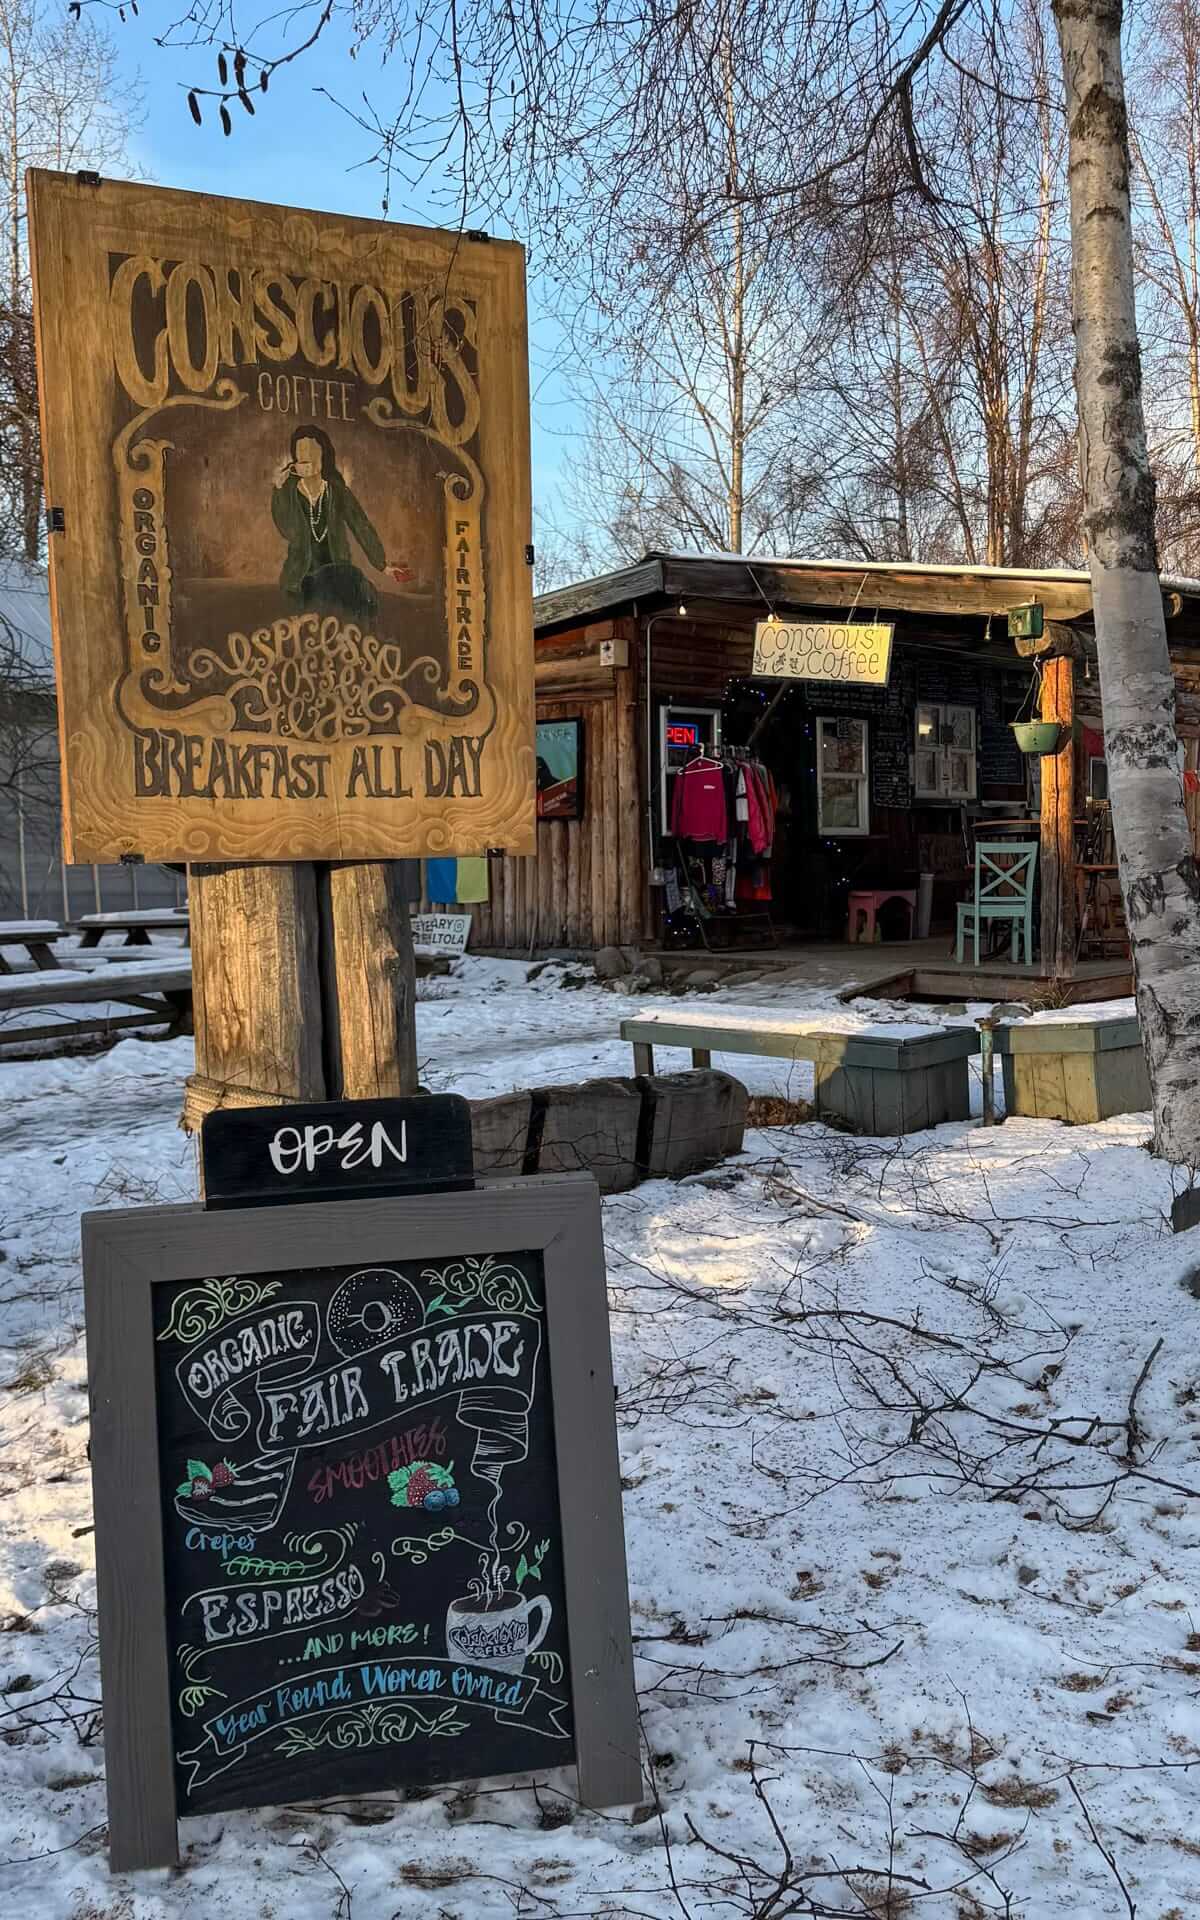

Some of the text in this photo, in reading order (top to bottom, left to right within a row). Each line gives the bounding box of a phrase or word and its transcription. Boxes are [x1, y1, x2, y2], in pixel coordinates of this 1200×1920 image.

[110, 254, 481, 446] CONSCIOUS
[256, 370, 356, 422] COFFEE
[132, 487, 161, 653] ORGANIC
[133, 727, 489, 800] BREAKFAST ALL DAY
[268, 1119, 407, 1175] OPEN
[187, 1309, 312, 1399] ORGANIC
[264, 1320, 525, 1443] FAIR TRADE
[307, 1415, 449, 1504] SMOOTHIES
[185, 1526, 257, 1559] Crepes
[199, 1563, 366, 1643] ESPRESSO
[214, 1700, 271, 1745] Year
[359, 1664, 448, 1695] Women
[451, 1667, 525, 1706] Owned
